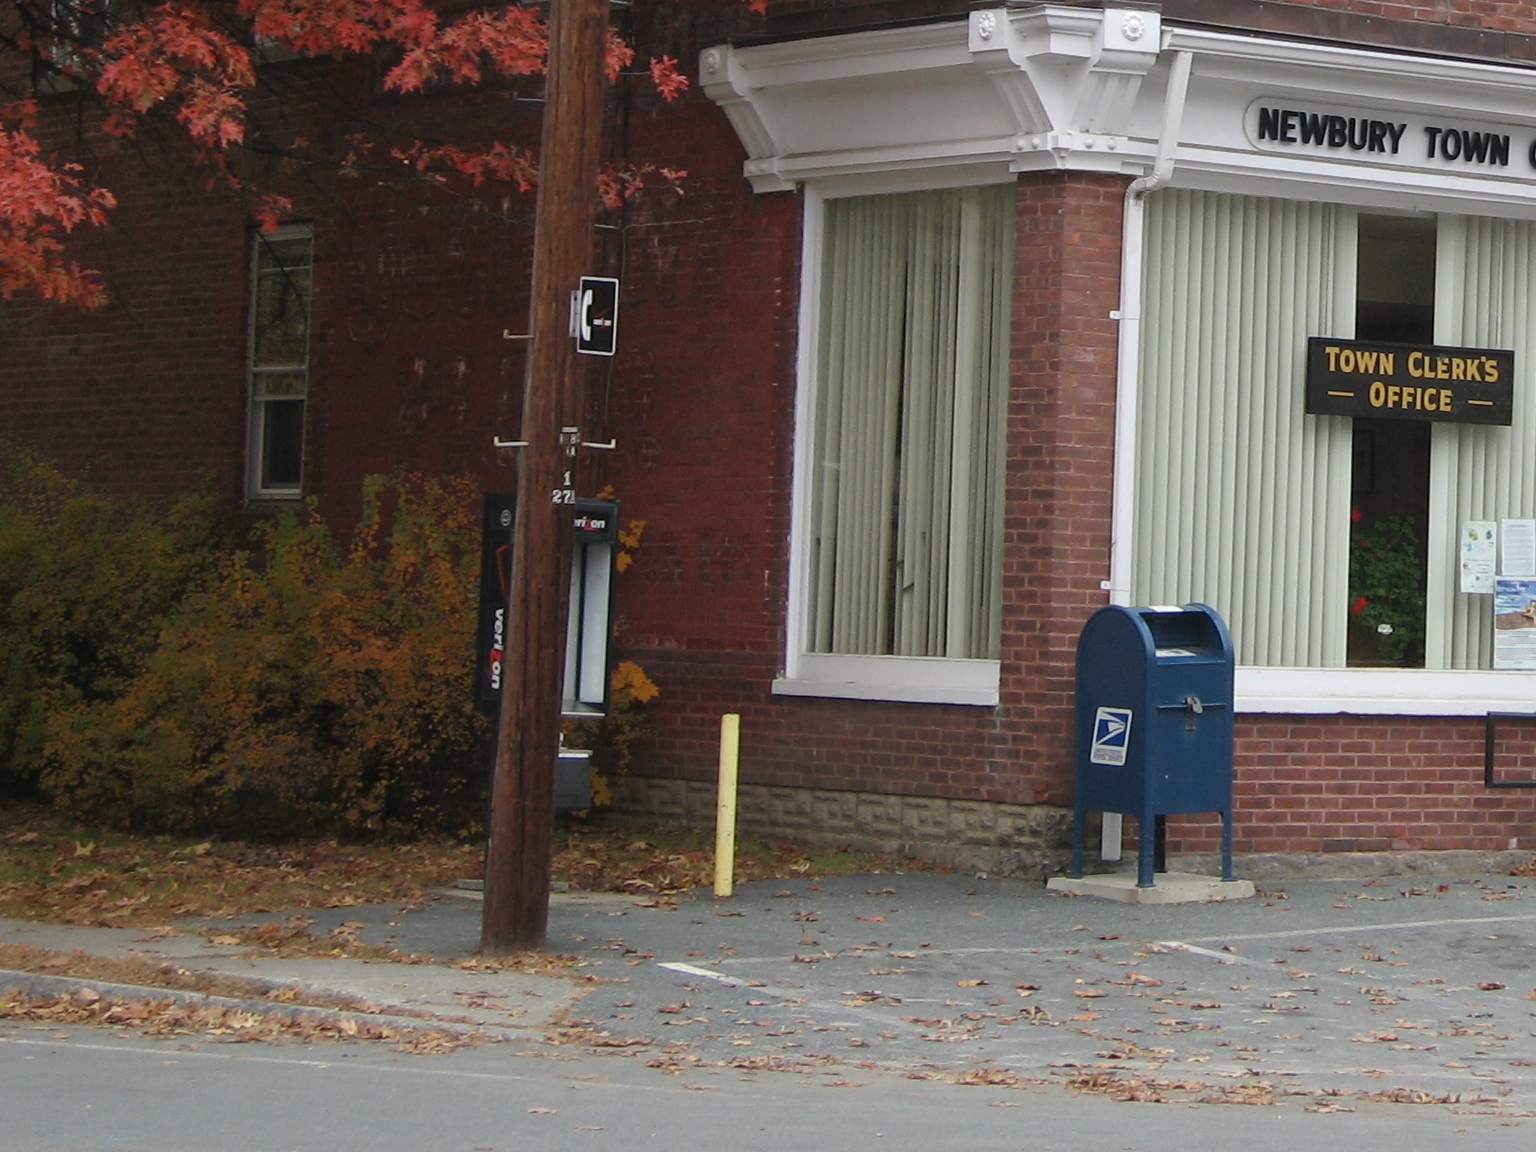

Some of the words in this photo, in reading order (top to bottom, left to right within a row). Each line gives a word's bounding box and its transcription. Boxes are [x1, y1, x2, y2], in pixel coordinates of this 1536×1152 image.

[1258, 108, 1407, 154] NEWBURY
[1424, 127, 1510, 166] TOWN
[1325, 346, 1394, 376] TOWN
[1408, 351, 1499, 383] CLERK'S
[1369, 381, 1453, 412] OFFICE
[573, 516, 606, 530] rizon
[490, 608, 504, 689] verizon
